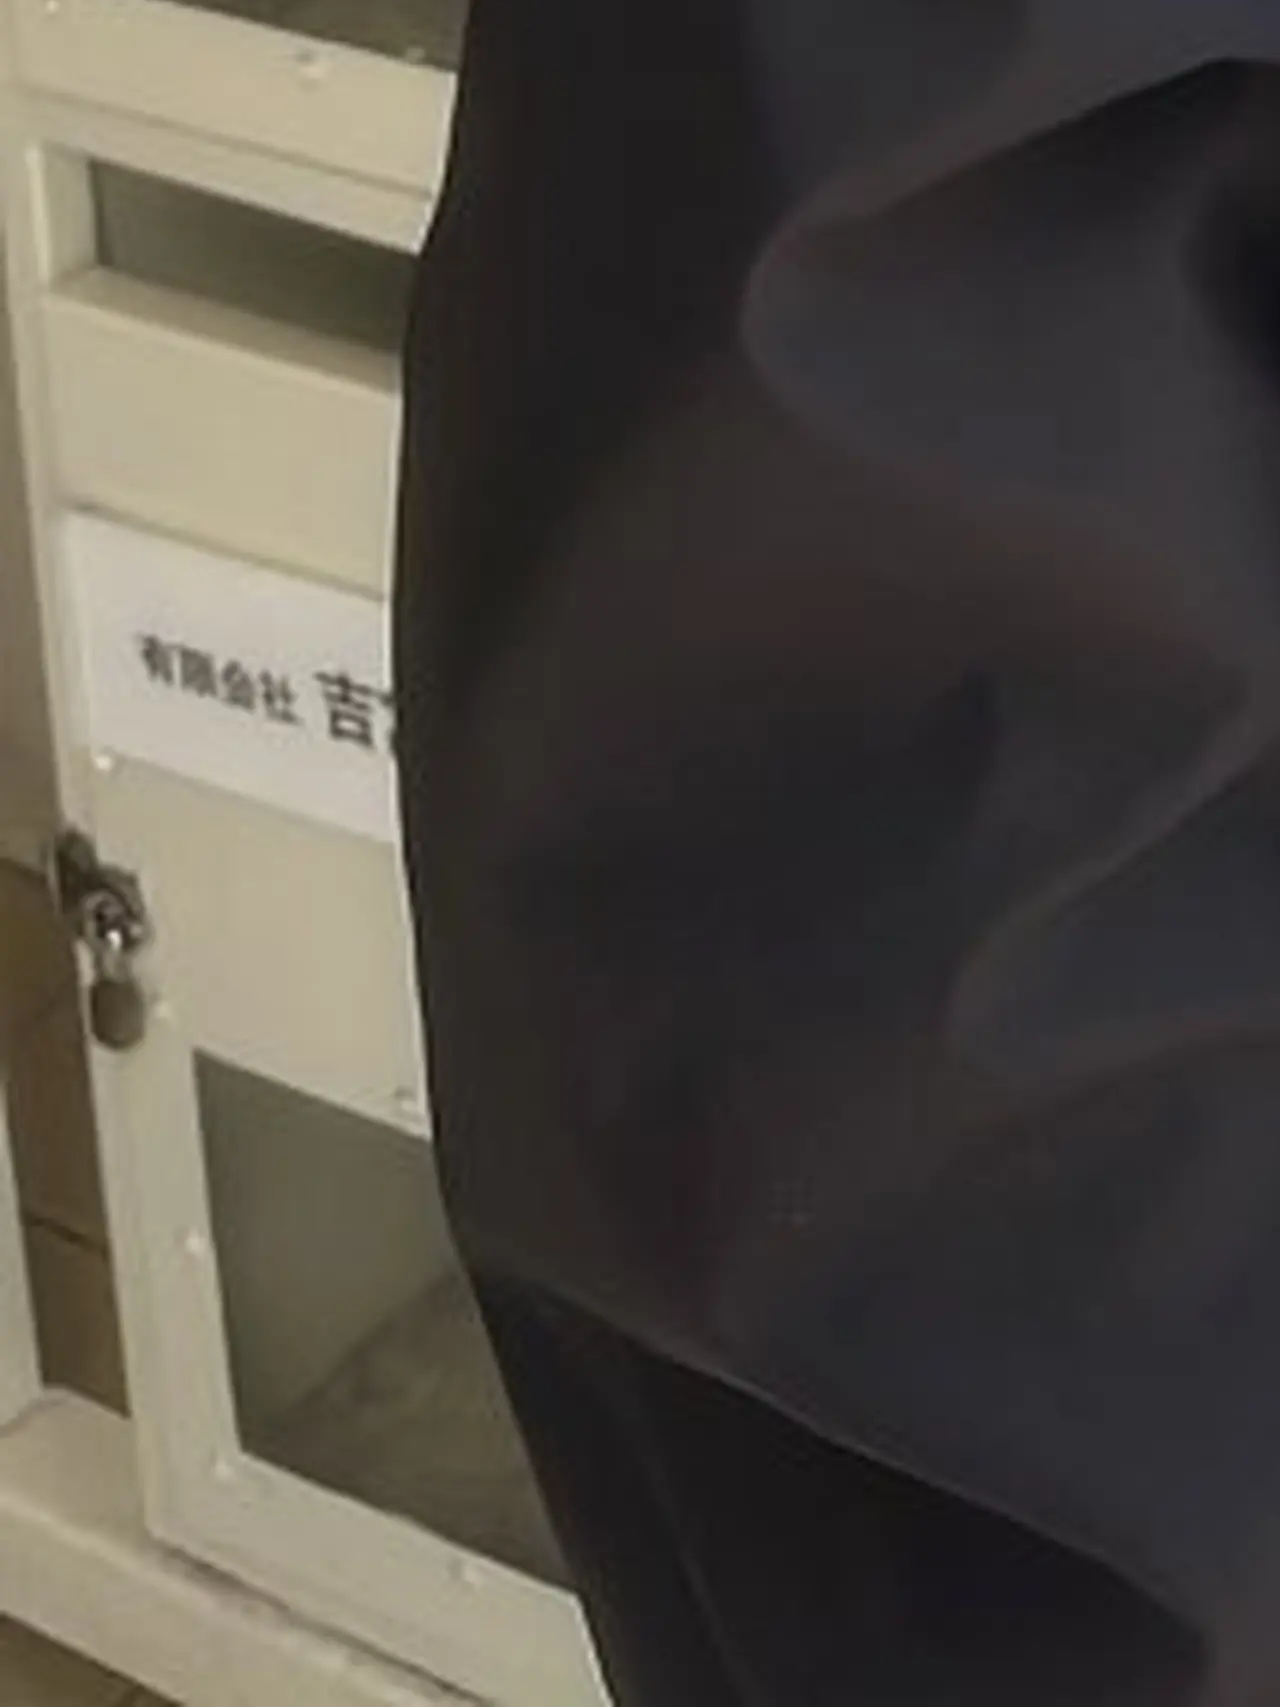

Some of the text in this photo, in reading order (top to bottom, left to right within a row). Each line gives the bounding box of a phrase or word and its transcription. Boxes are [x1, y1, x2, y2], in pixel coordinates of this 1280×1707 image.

[138, 631, 393, 752] 有限会社 吉
